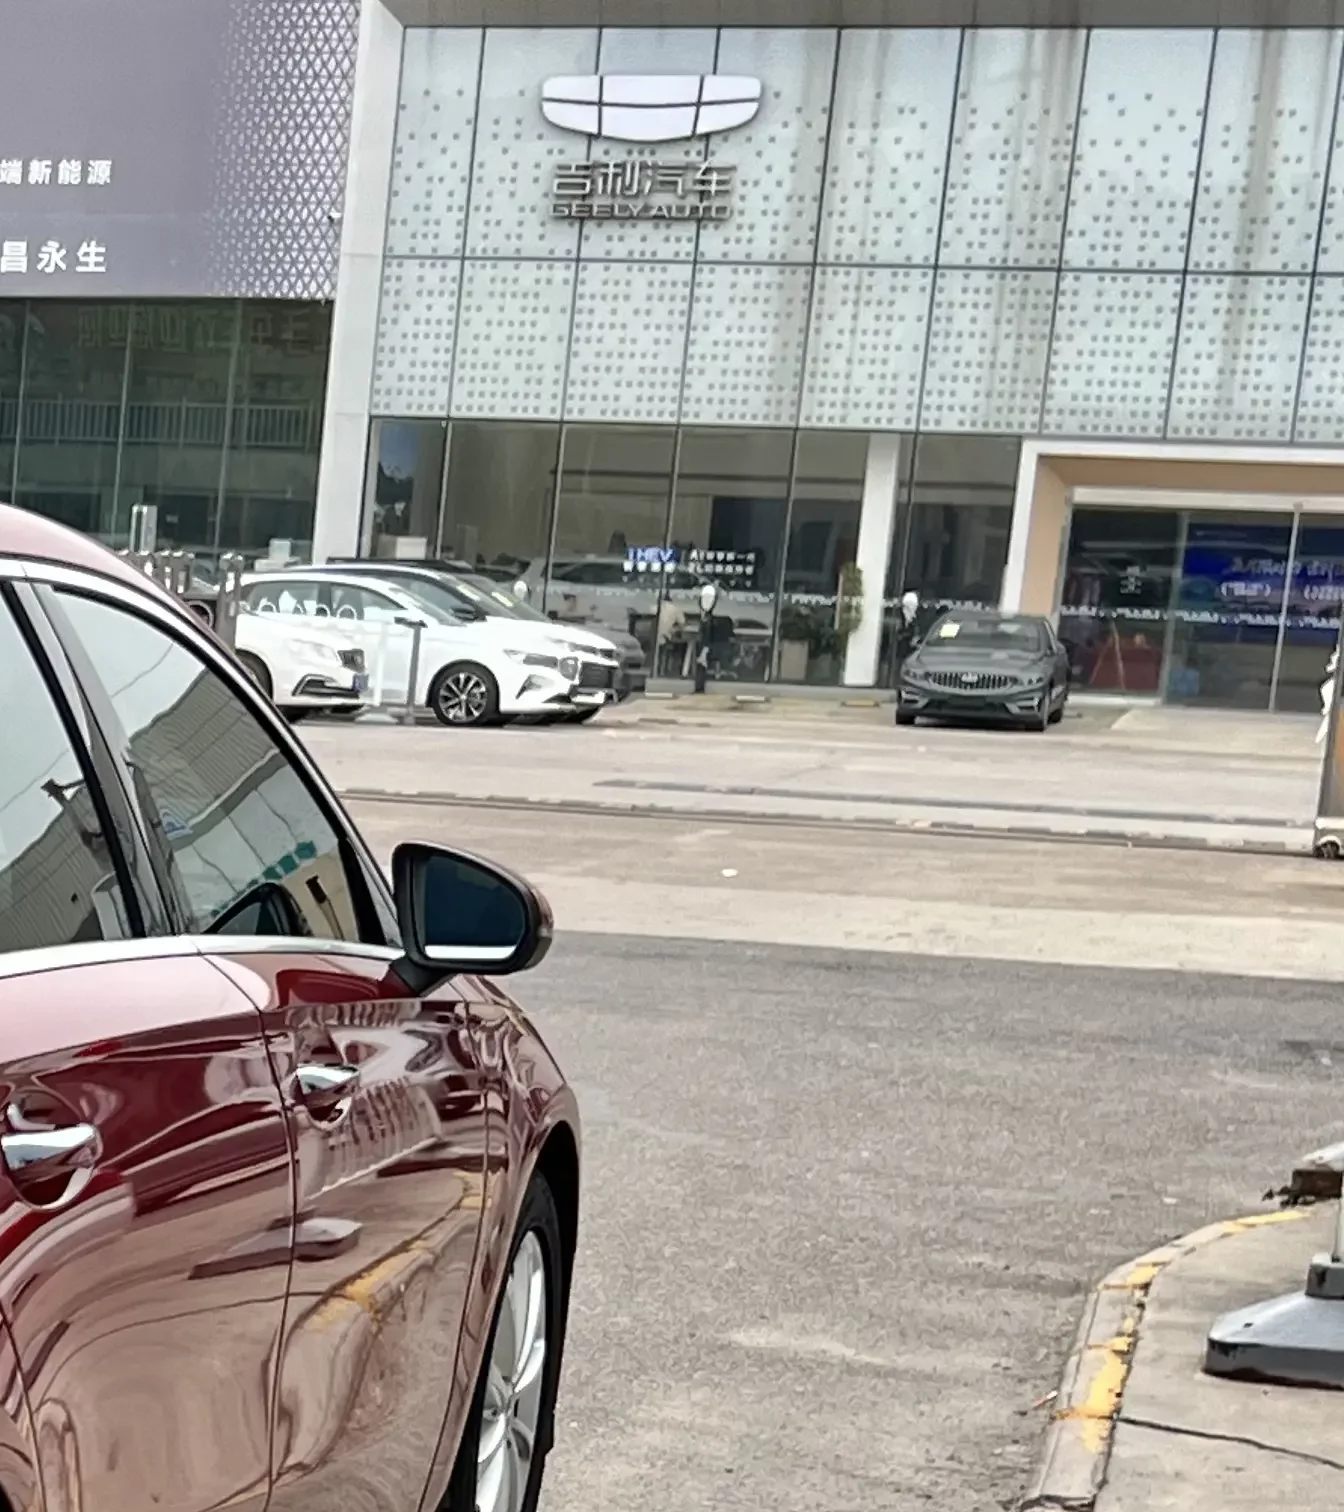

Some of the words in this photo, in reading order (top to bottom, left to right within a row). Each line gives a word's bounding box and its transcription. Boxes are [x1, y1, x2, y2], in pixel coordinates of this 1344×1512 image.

[553, 160, 734, 196] 吉利汽车
[551, 203, 644, 218] GEELY
[650, 203, 733, 218] AUTO
